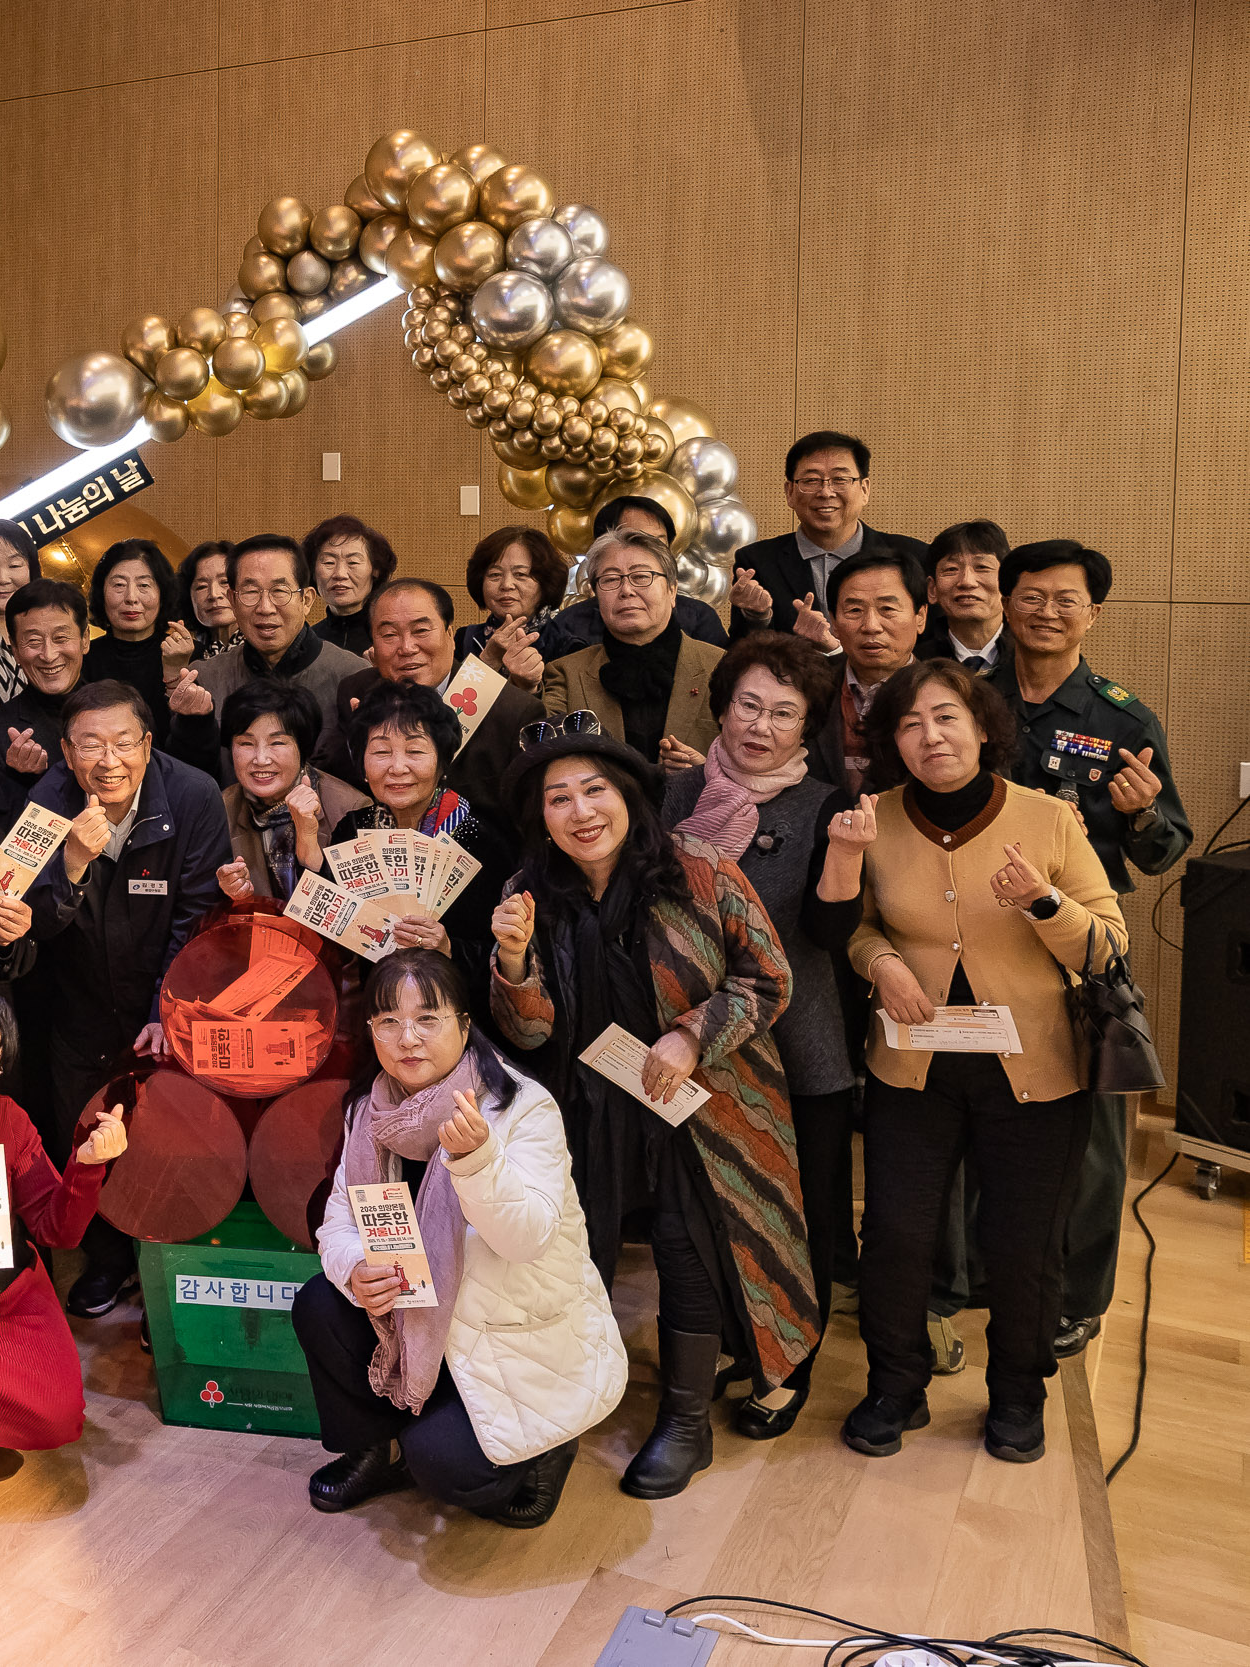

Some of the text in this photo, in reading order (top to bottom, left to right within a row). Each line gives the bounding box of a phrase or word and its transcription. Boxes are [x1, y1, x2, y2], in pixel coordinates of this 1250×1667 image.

[32, 475, 115, 535] 나눔의
[109, 458, 145, 493] 날
[16, 825, 54, 849] 따뜻한
[11, 836, 47, 857] 겨울나기
[336, 861, 351, 870] 2026
[382, 855, 408, 867] 뜻한
[339, 860, 380, 881] 따뜻한
[388, 868, 408, 876] 나기
[343, 872, 384, 890] 겨울나기
[303, 906, 313, 920] 2026
[309, 888, 336, 926] 따뜻한
[321, 894, 345, 930] 겨울나기
[218, 1028, 231, 1069] 따뜻한
[360, 1205, 377, 1213] 2026
[361, 1211, 409, 1227] 따뜻한
[365, 1226, 412, 1238] 겨울나기
